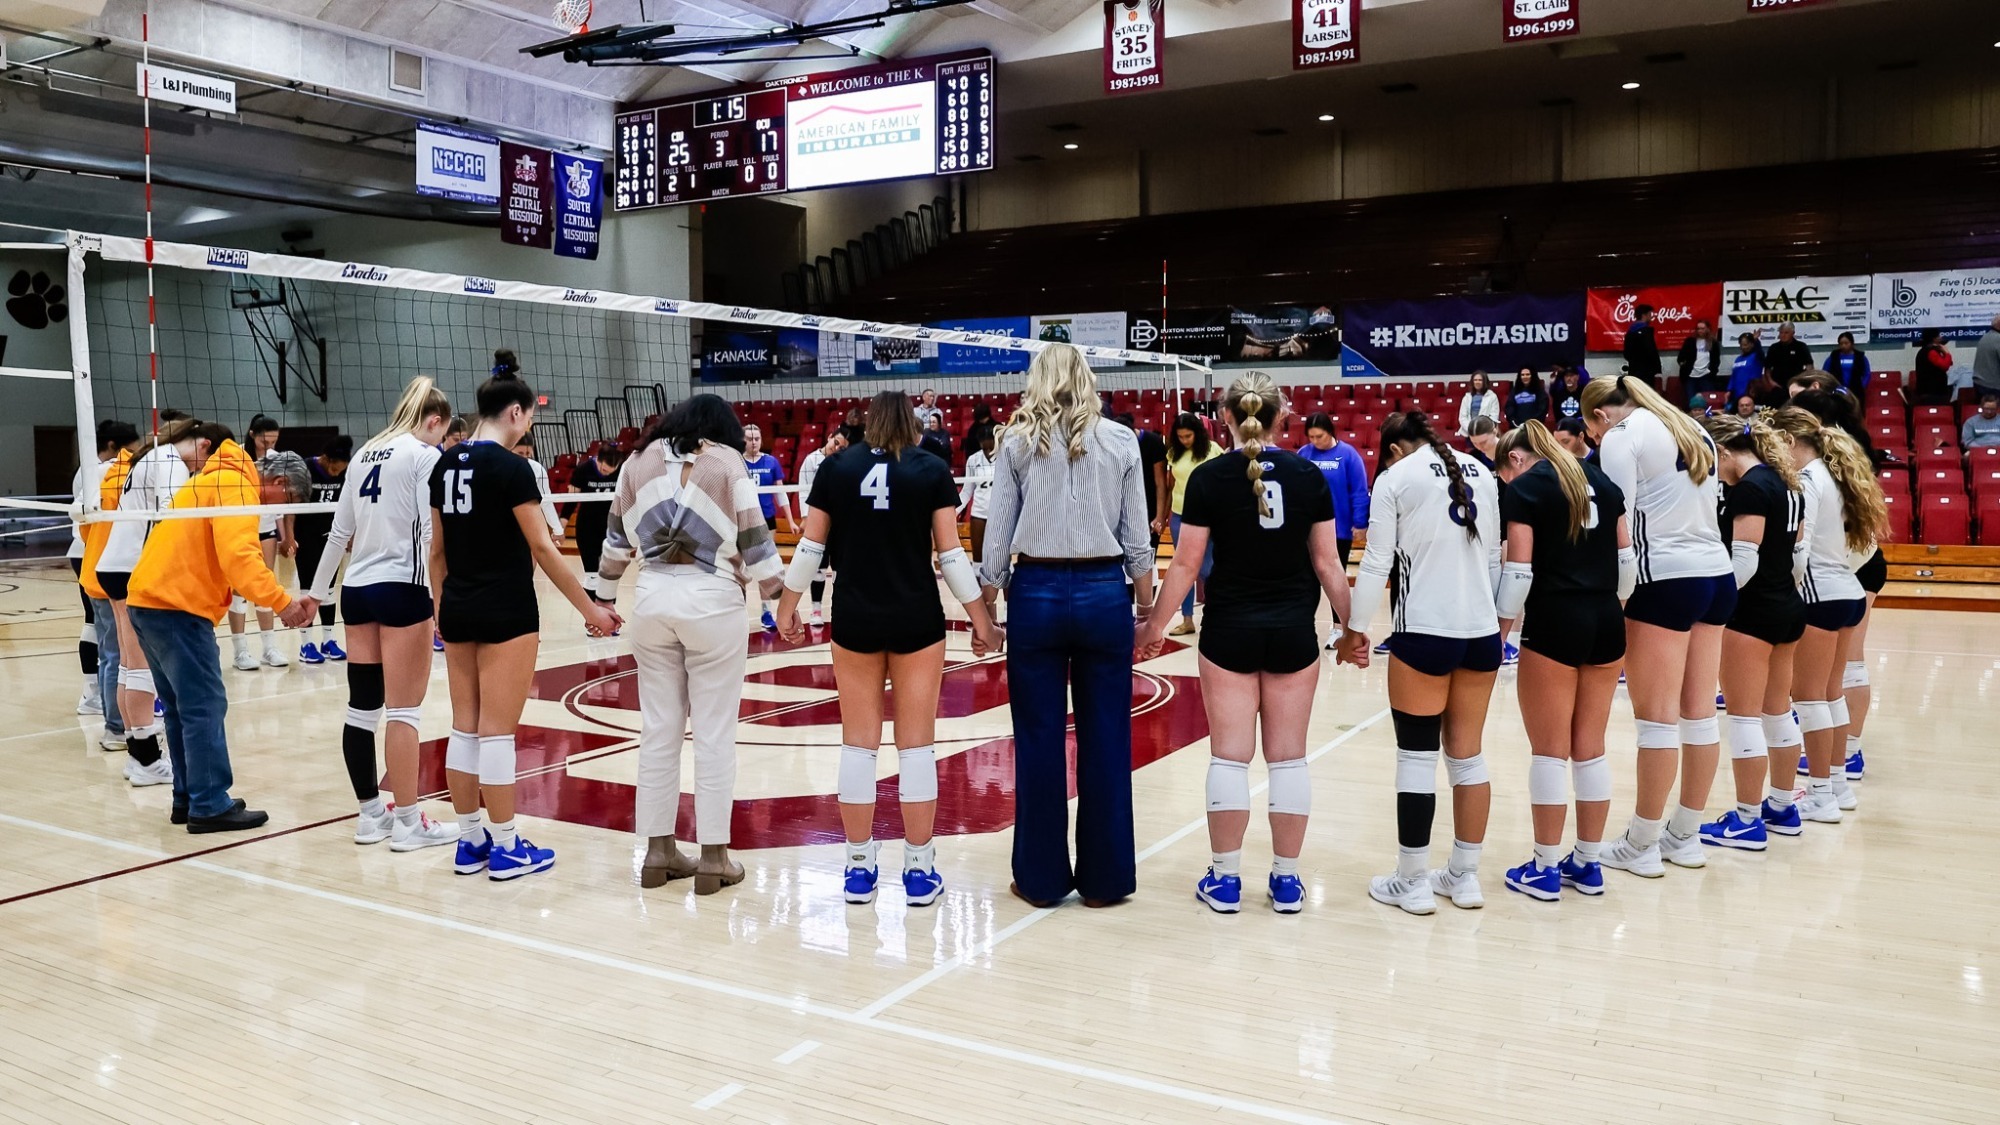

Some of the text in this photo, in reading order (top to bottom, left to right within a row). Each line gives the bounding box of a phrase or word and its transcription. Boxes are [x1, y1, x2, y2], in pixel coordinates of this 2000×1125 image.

[1516, 0, 1567, 13] ST. CLAIR
[1313, 7, 1340, 28] 41
[1114, 24, 1152, 38] STACEY
[1508, 18, 1574, 37] 1996-1999
[1305, 29, 1349, 44] LARSEN
[1120, 35, 1147, 56] 35
[1117, 56, 1152, 69] FRITTS
[1299, 48, 1355, 65] 1987-1991
[957, 64, 970, 73] ACES
[974, 62, 986, 70] KILLS
[765, 75, 808, 88] DAKTRONICS
[810, 68, 923, 94] WELCOME to THE K
[1110, 74, 1159, 90] 1987-1991
[163, 77, 231, 103] L&J Plumbing
[713, 98, 743, 121] 1:15
[623, 127, 630, 138] 3
[710, 131, 729, 139] PERIOD
[798, 114, 920, 140] AMERICAN FAMILY
[961, 123, 968, 136] 3
[715, 141, 724, 157] 3
[761, 131, 777, 152] 17
[806, 131, 912, 152] INSURANCE
[981, 136, 988, 150] 3
[433, 148, 484, 177] NCCAA
[669, 143, 689, 166] 25
[762, 154, 779, 162] FOULS
[632, 166, 638, 178] 3
[704, 162, 722, 170] PLAYER
[745, 163, 777, 183] 0 0
[512, 183, 539, 198] SOUTH
[668, 176, 677, 192] 2
[712, 188, 729, 196] MATCH
[760, 182, 778, 191] SCORE
[510, 196, 542, 212] CENTRAL
[567, 198, 591, 213] SOUTH
[618, 194, 630, 207] 30
[509, 209, 543, 225] MISSOURI
[564, 213, 595, 228] CENTRAL
[563, 227, 598, 243] MISSOURI
[208, 248, 248, 266] NCCAA
[342, 264, 388, 281] Baden
[465, 277, 496, 292] NCCAA
[1962, 277, 1977, 286] (5)
[1726, 286, 1819, 312] TRAC
[1930, 289, 1958, 298] ready
[1736, 313, 1819, 323] MATERIALS
[1878, 308, 1930, 317] BRANSON
[714, 349, 768, 363] KANAKUK
[361, 448, 394, 463] RAMS
[1430, 463, 1479, 477] RMS
[359, 464, 382, 503] 4
[442, 469, 474, 514] 15
[860, 463, 889, 510] 4
[1259, 481, 1284, 529] 9
[1448, 482, 1477, 526] 8
[1786, 490, 1800, 532] 11
